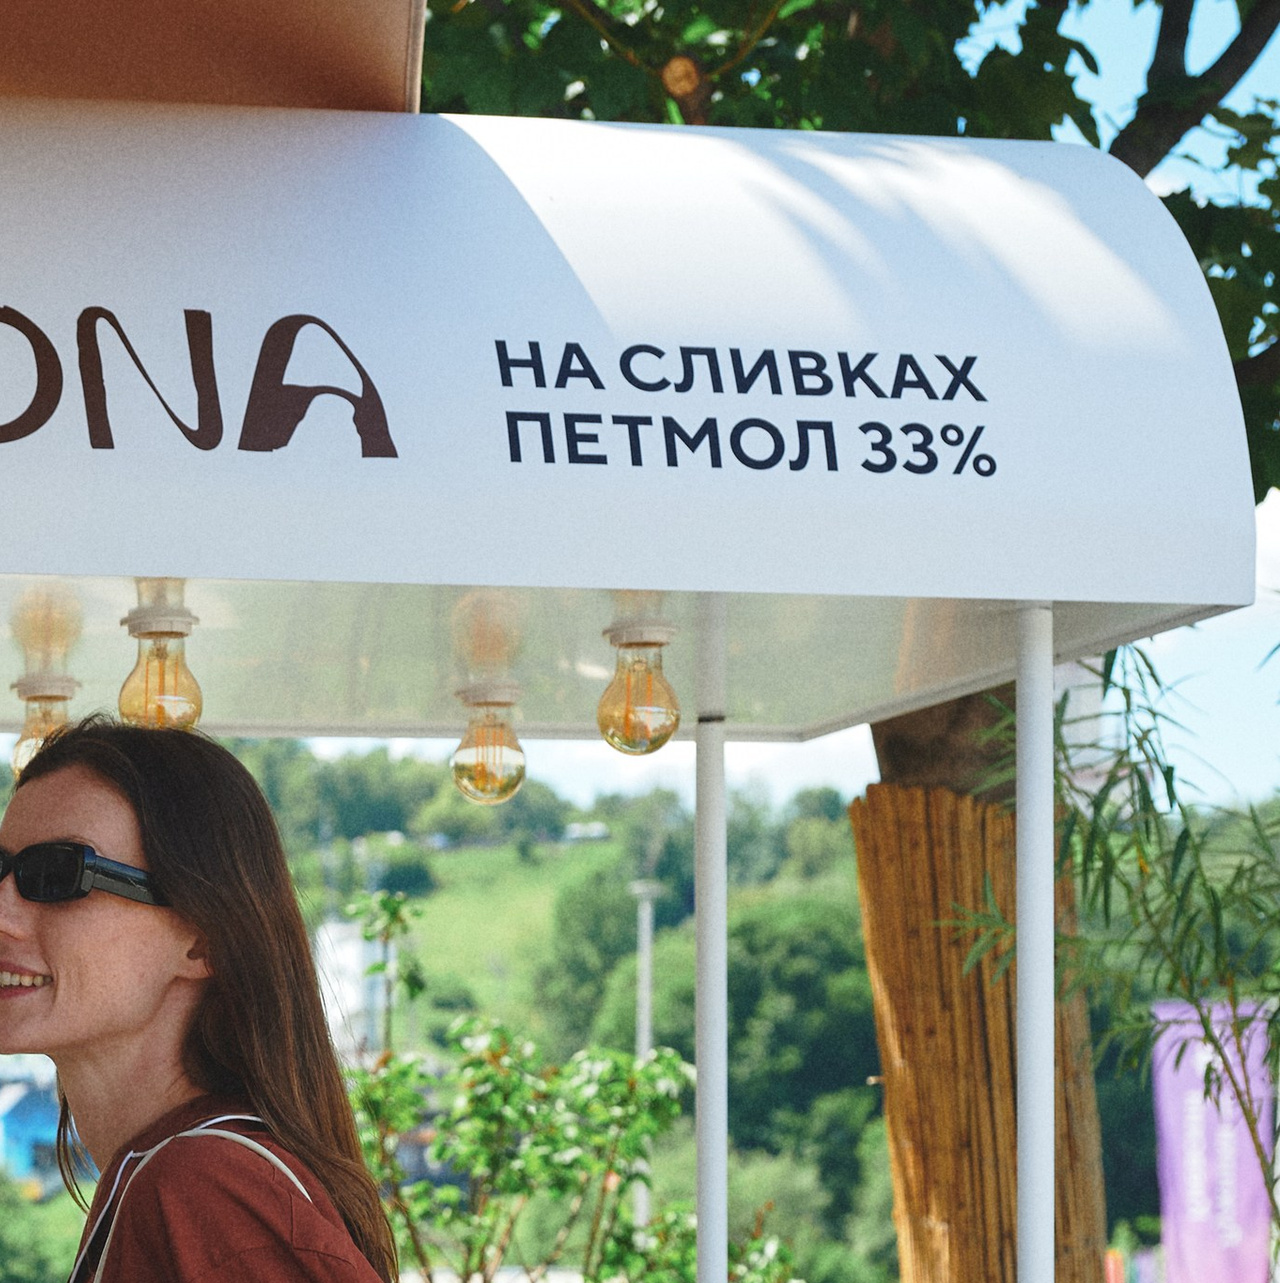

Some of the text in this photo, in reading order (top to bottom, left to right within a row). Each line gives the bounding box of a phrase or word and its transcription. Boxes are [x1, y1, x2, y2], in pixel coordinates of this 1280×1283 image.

[495, 341, 986, 401] НА СЛИВКАХ
[506, 412, 996, 476] ПЕТМОЛ 33%
